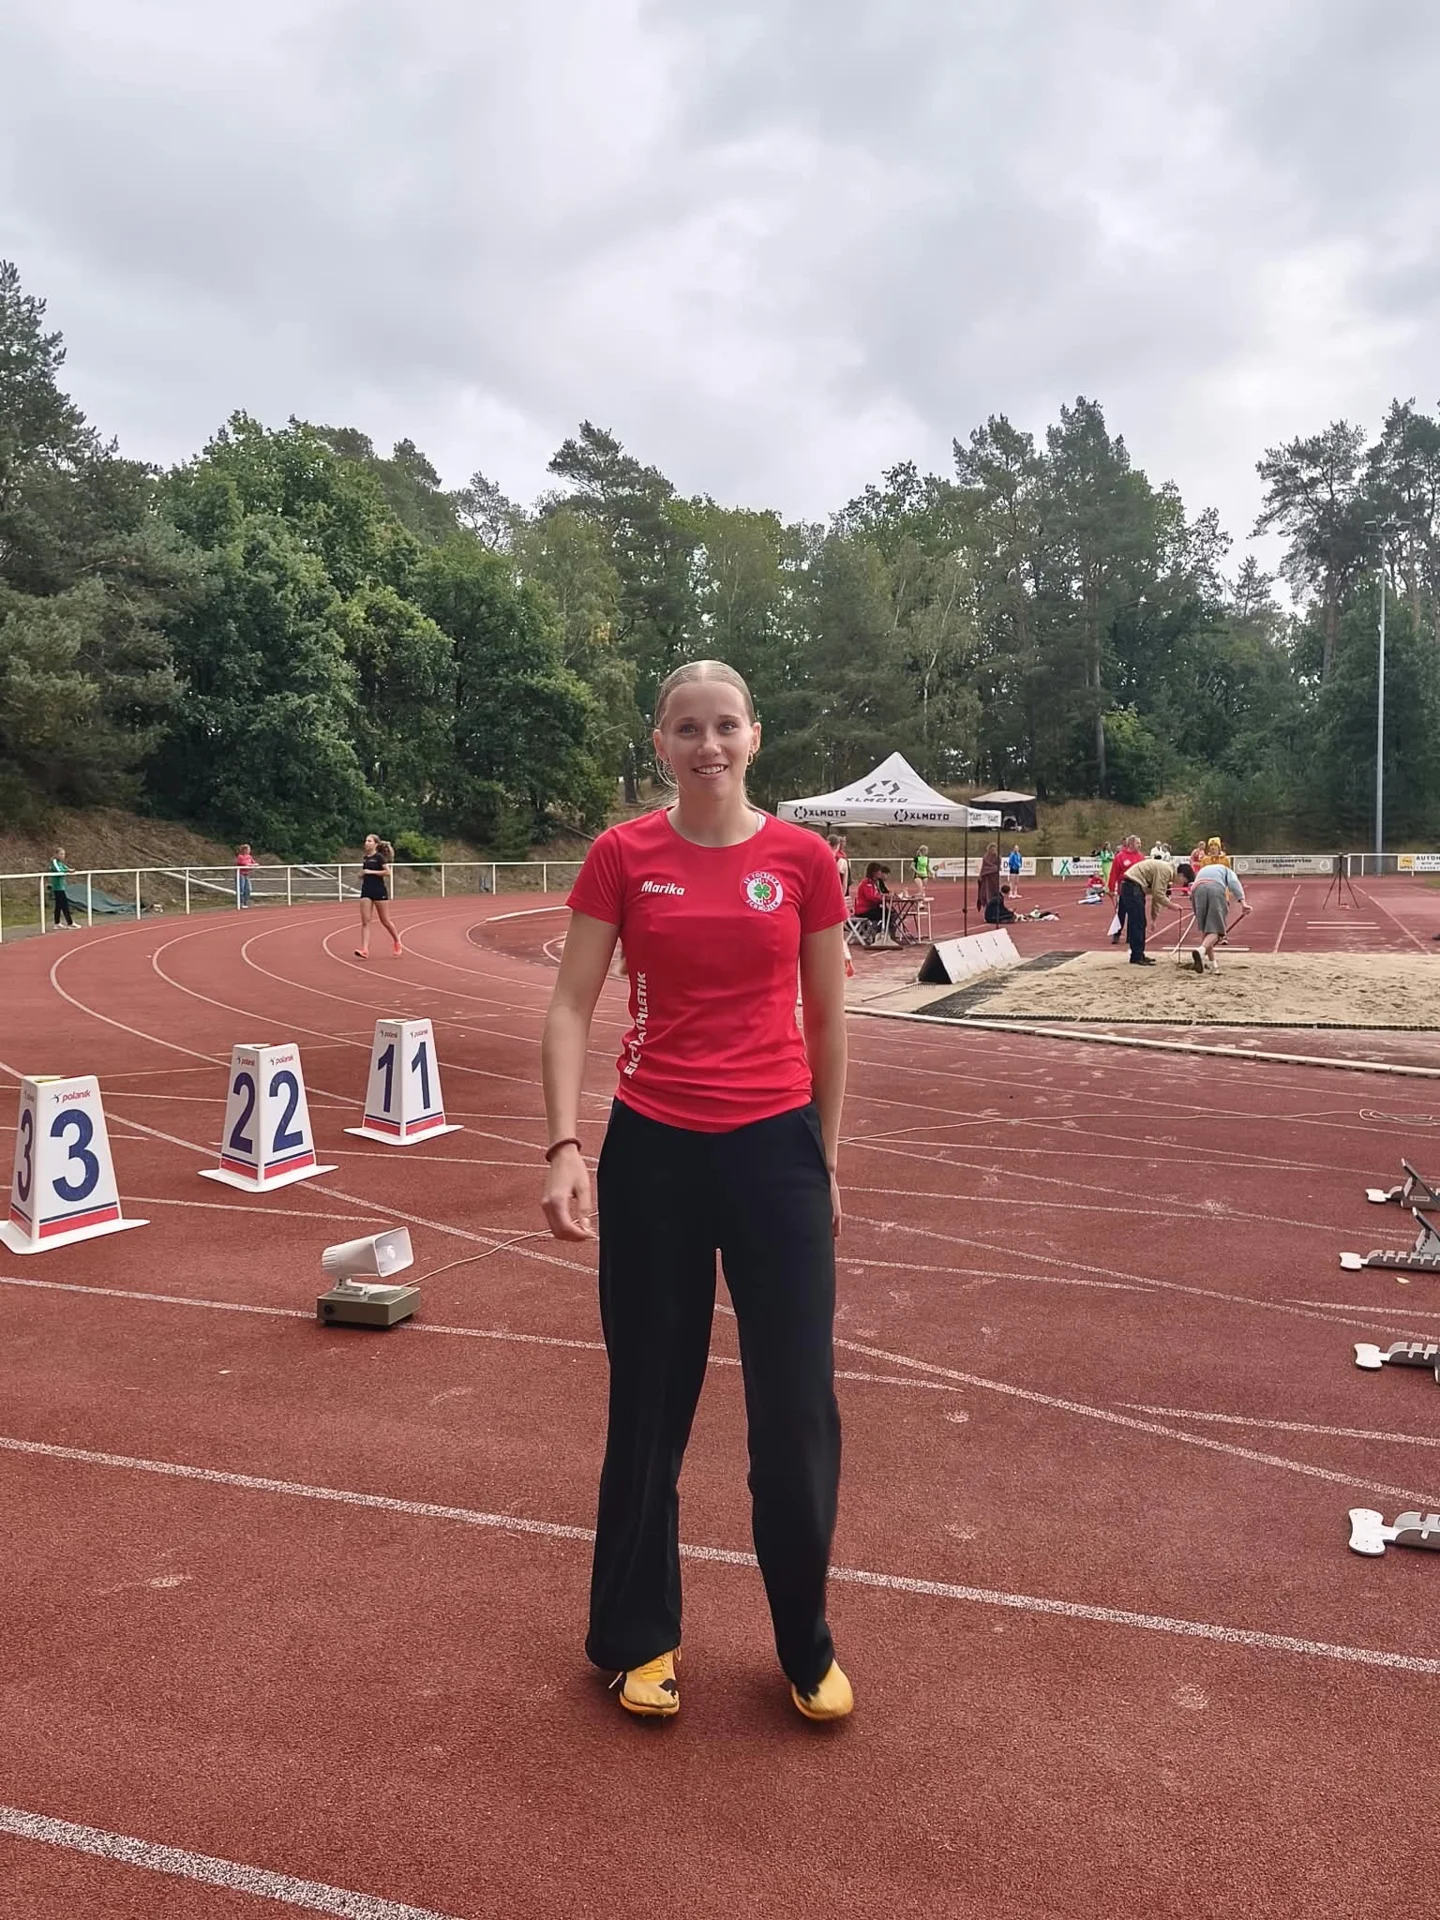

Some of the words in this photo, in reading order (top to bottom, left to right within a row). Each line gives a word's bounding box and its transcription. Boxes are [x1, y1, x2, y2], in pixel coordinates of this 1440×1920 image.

[909, 813, 950, 821] XLMOTO
[640, 880, 686, 896] Marika
[61, 1089, 91, 1103] polanik
[377, 1043, 395, 1113] 1
[411, 1041, 431, 1110] 1
[229, 1072, 256, 1155] 2
[268, 1070, 304, 1153] 2
[17, 1108, 33, 1202] 3
[50, 1108, 100, 1202] 3
